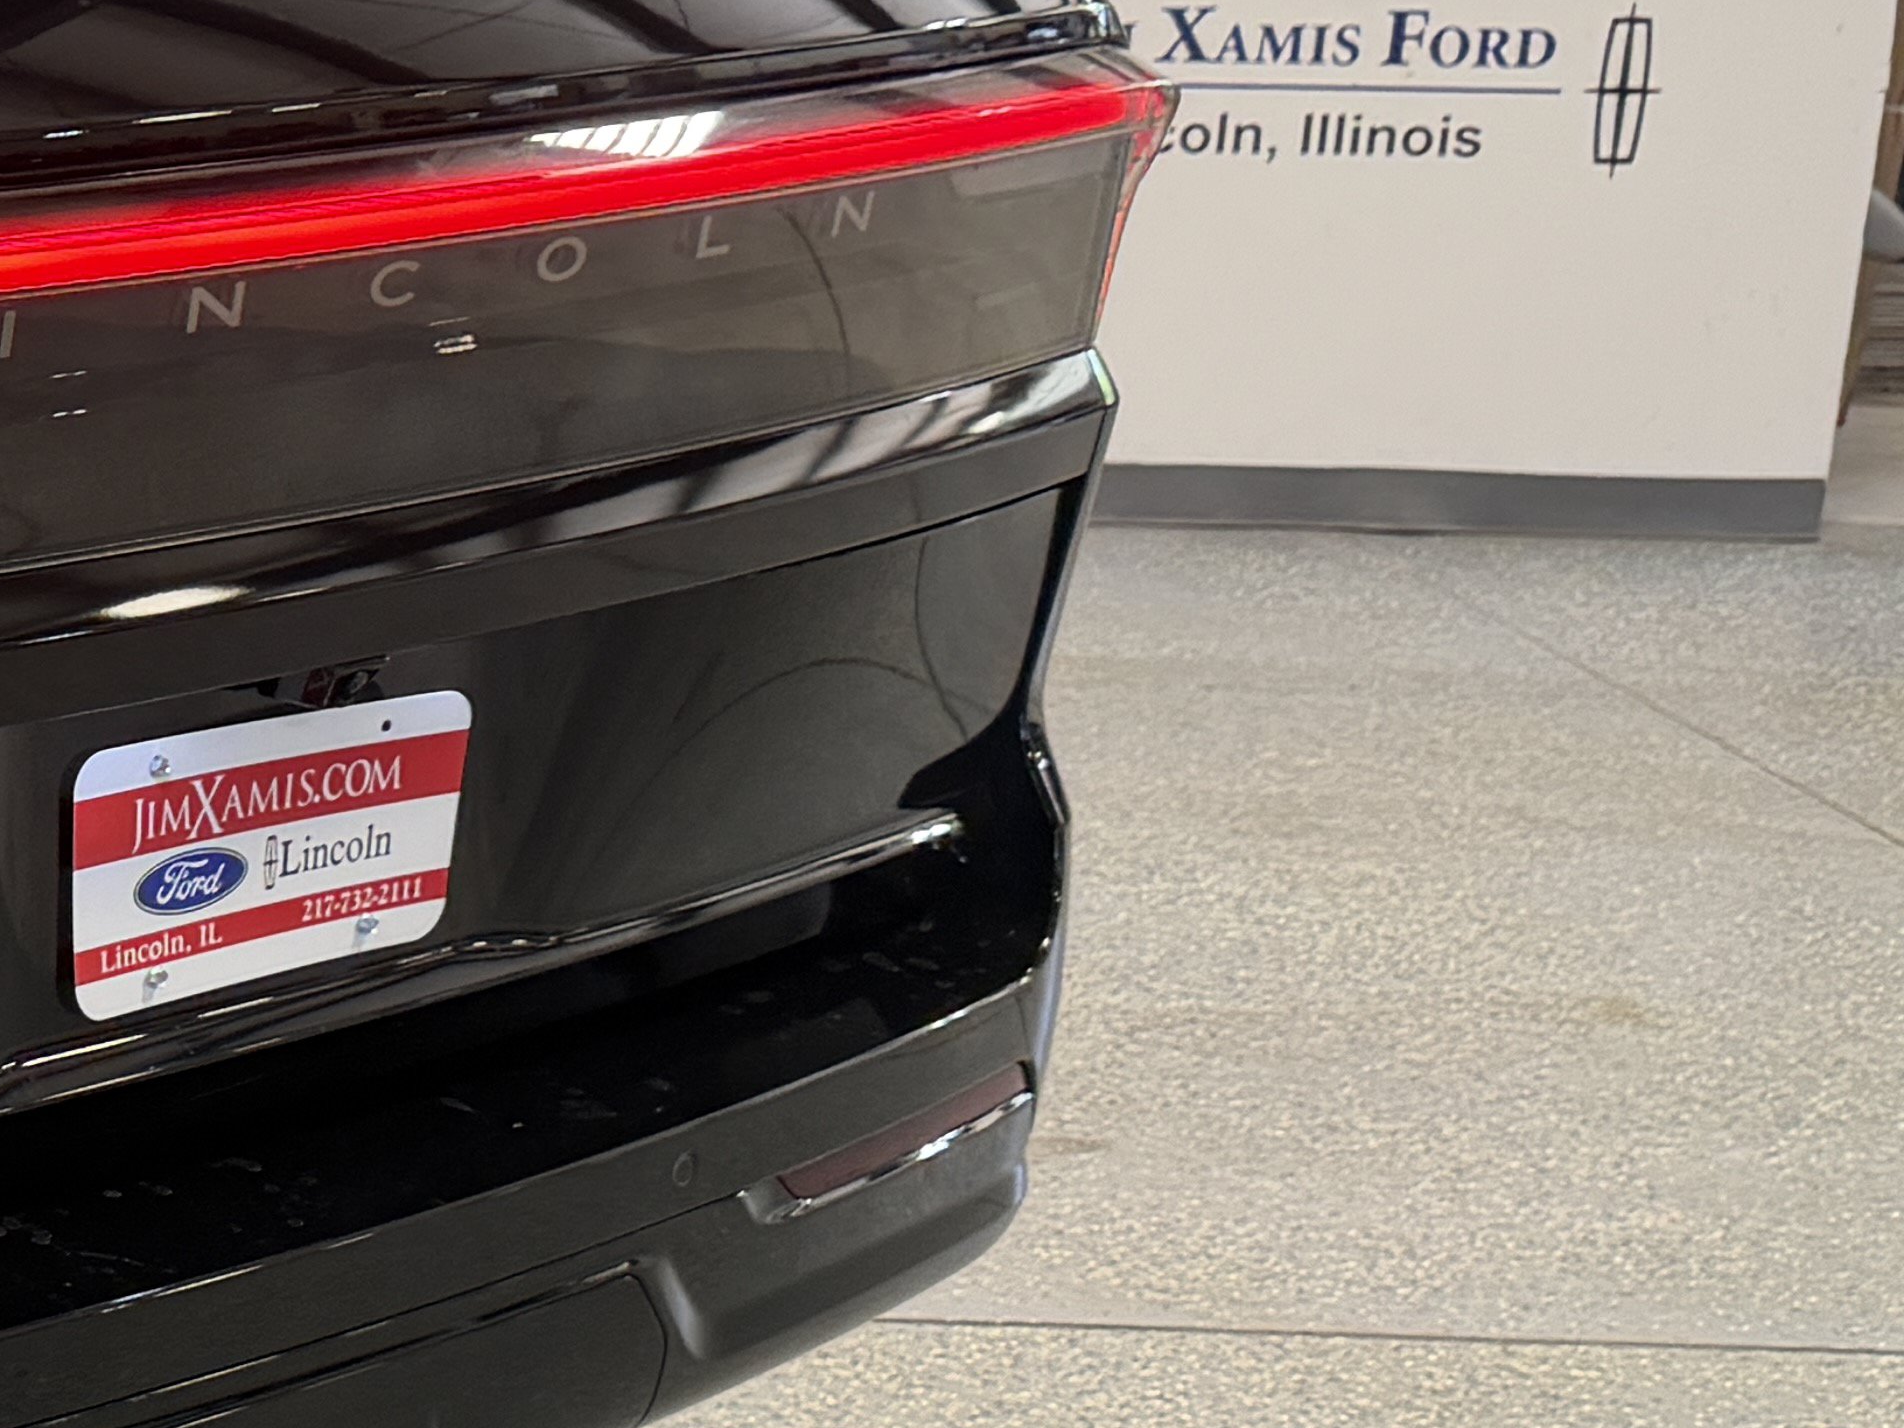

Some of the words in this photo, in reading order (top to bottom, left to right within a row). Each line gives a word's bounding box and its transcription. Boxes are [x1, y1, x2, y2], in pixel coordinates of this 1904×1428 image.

[1300, 112, 1482, 158] Illinois
[279, 824, 391, 877] Lincoln
[302, 877, 421, 922] 217-732-2111
[200, 922, 223, 947] IL
